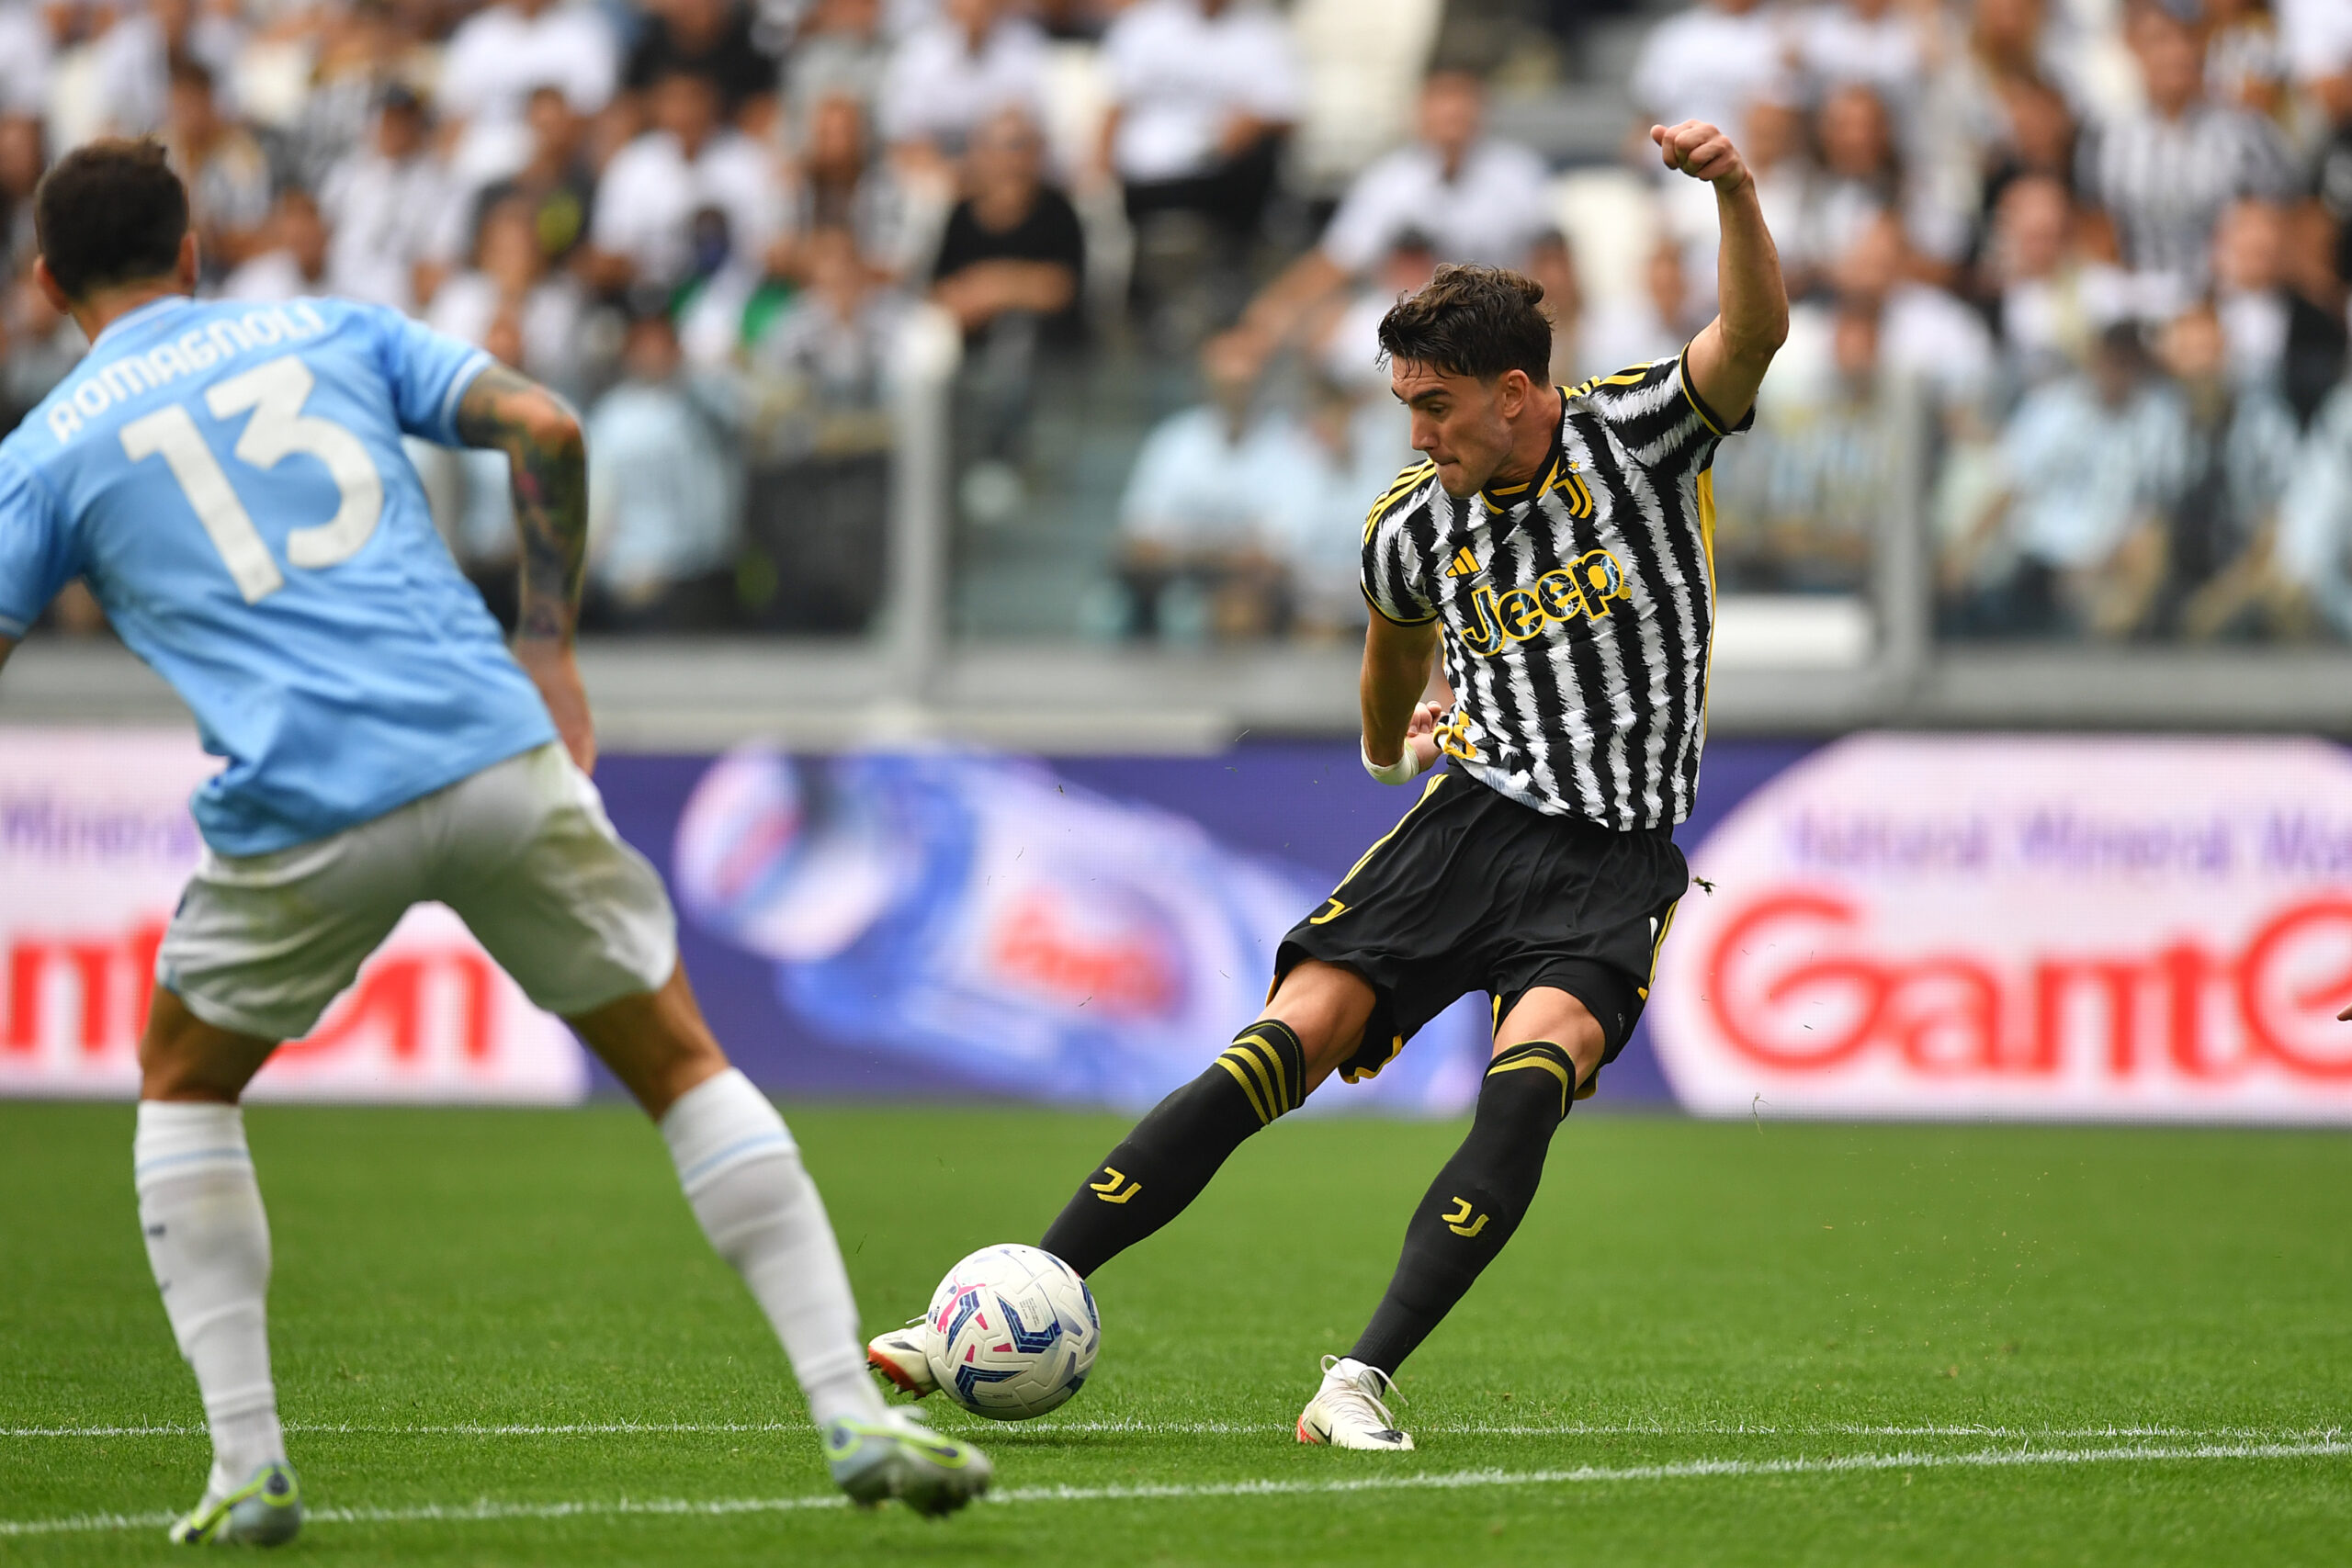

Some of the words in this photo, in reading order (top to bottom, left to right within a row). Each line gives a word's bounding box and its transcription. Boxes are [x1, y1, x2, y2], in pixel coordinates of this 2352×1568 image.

[47, 300, 327, 444] ROMAGNOLI
[119, 354, 384, 605] 13
[1460, 548, 1624, 657] Jeep
